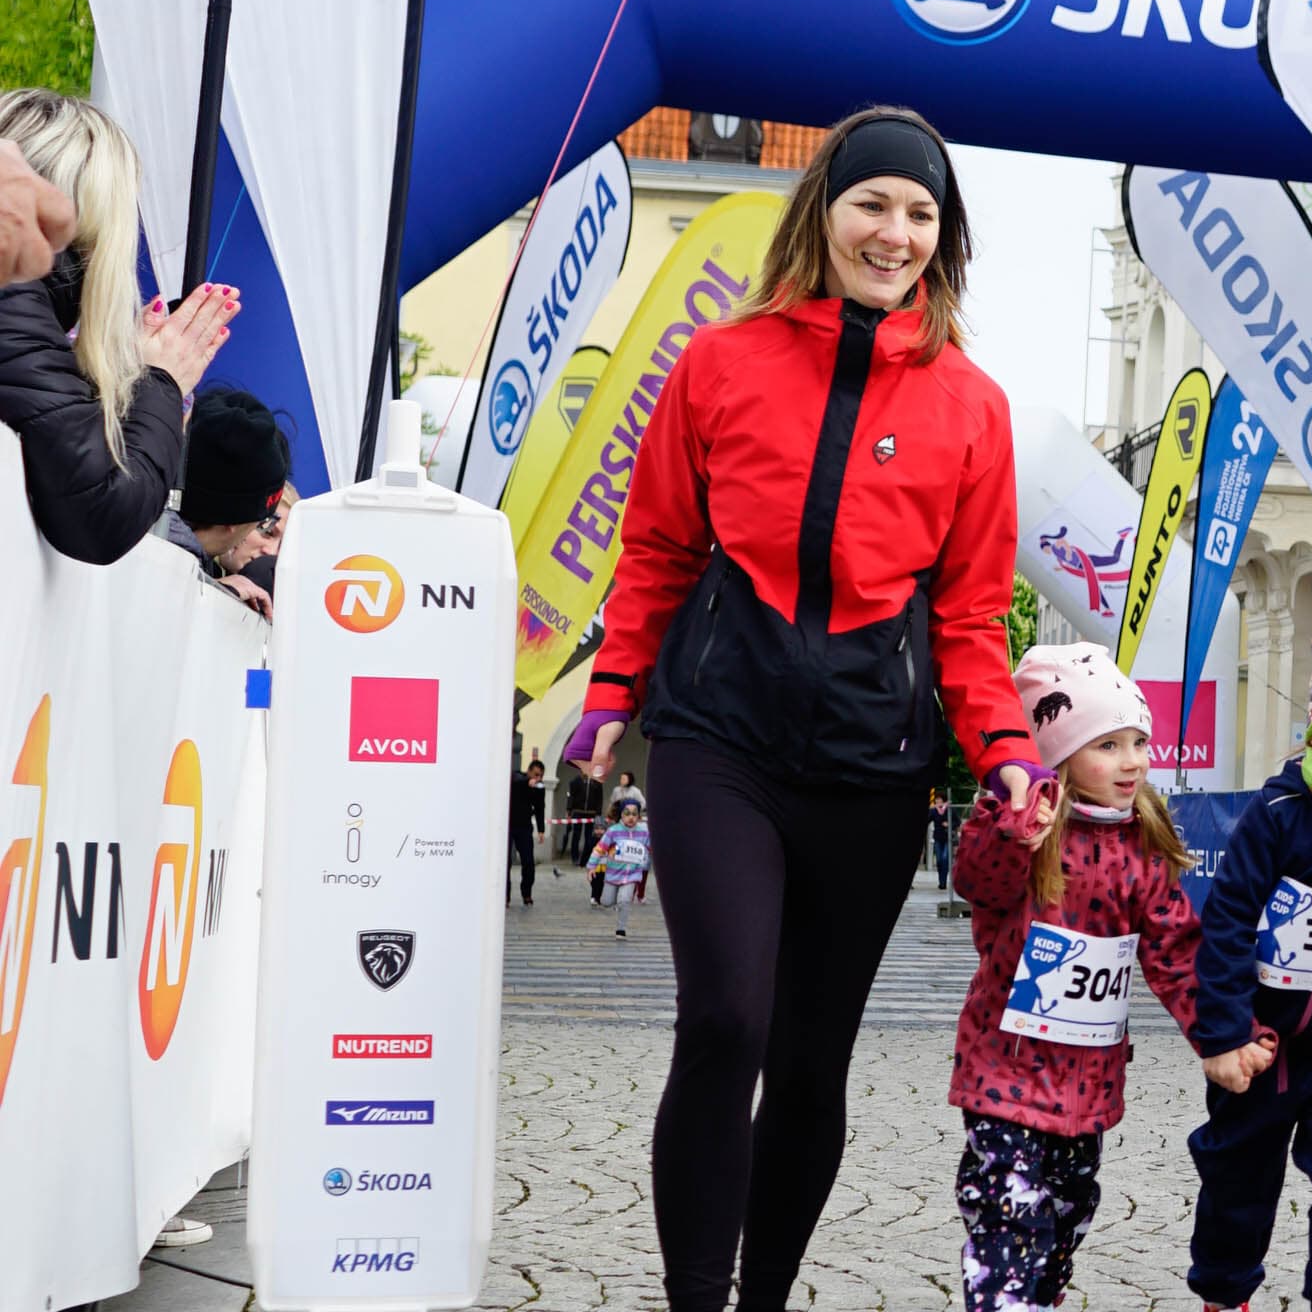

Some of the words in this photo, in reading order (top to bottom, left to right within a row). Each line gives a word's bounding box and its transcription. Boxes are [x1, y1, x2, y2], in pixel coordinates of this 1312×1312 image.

[528, 171, 618, 373] ŠKODA
[1129, 484, 1181, 636] RUNTO
[421, 583, 475, 610] NN
[357, 738, 428, 756] AVON
[1147, 744, 1208, 763] AVON
[415, 838, 455, 847] Powered
[414, 849, 426, 858] by
[430, 849, 454, 857] MVM
[323, 870, 382, 888] innogy
[1274, 889, 1295, 905] KIDS
[1270, 902, 1290, 915] CUP
[362, 934, 411, 942] PEUGEOT
[1033, 936, 1063, 953] KIDS
[1031, 950, 1058, 963] CUP
[1064, 964, 1132, 1003] 3041
[338, 1039, 429, 1055] NUTREND
[356, 1170, 433, 1192] ŠKODA
[332, 1251, 416, 1273] KPMG
